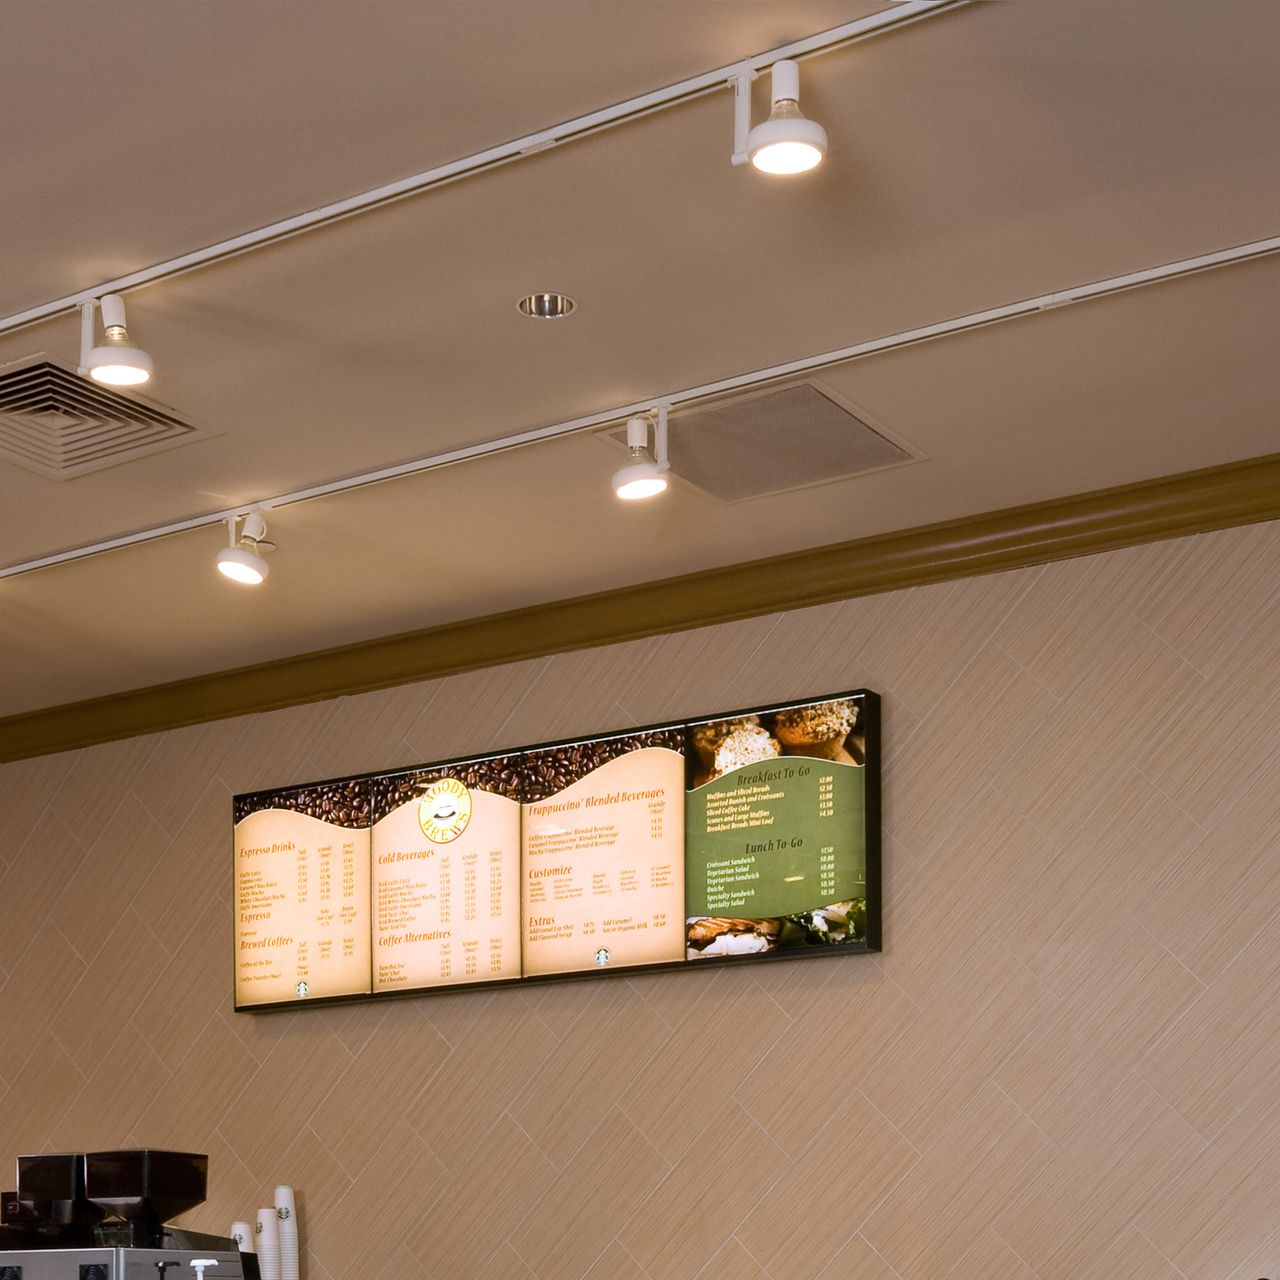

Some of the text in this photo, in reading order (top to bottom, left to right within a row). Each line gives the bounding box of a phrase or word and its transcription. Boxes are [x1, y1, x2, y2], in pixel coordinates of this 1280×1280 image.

[737, 771, 781, 786] Breakfast
[585, 792, 621, 807] Blended
[622, 788, 665, 801] Beverages
[423, 813, 468, 841] BREWS
[240, 841, 296, 859] Espresso Drinks
[746, 840, 774, 854] Lunch
[378, 849, 434, 865] Cold Beverages
[528, 865, 573, 879] Customize
[240, 912, 271, 923] Espresso
[529, 916, 555, 927] Extras
[240, 935, 293, 950] Brewed Coffees
[378, 929, 451, 947] Coffee Alternatives
